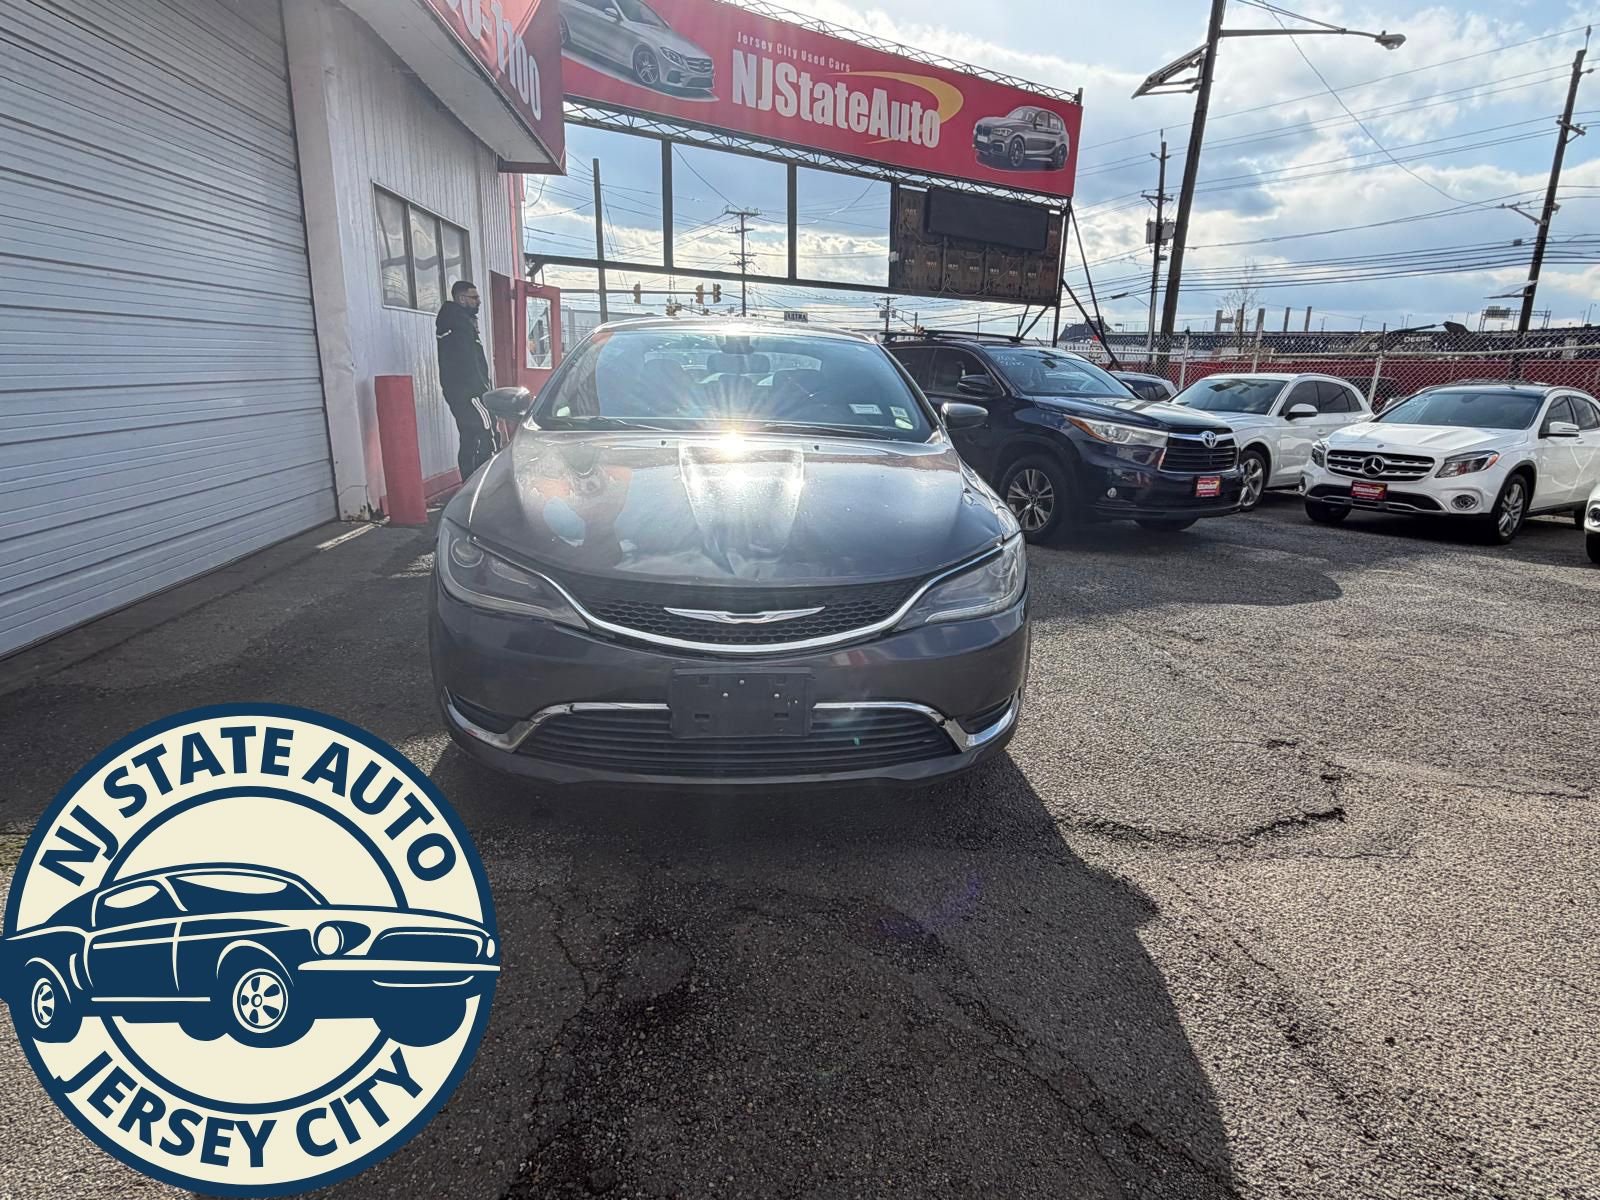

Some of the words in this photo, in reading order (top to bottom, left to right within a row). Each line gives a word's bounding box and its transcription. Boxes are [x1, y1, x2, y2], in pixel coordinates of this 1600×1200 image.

[445, 0, 541, 121] -1100
[732, 49, 941, 149] NJStateAuto
[736, 31, 773, 53] Jersey
[776, 42, 798, 60] City
[801, 50, 825, 66] Used
[828, 57, 850, 73] Cars
